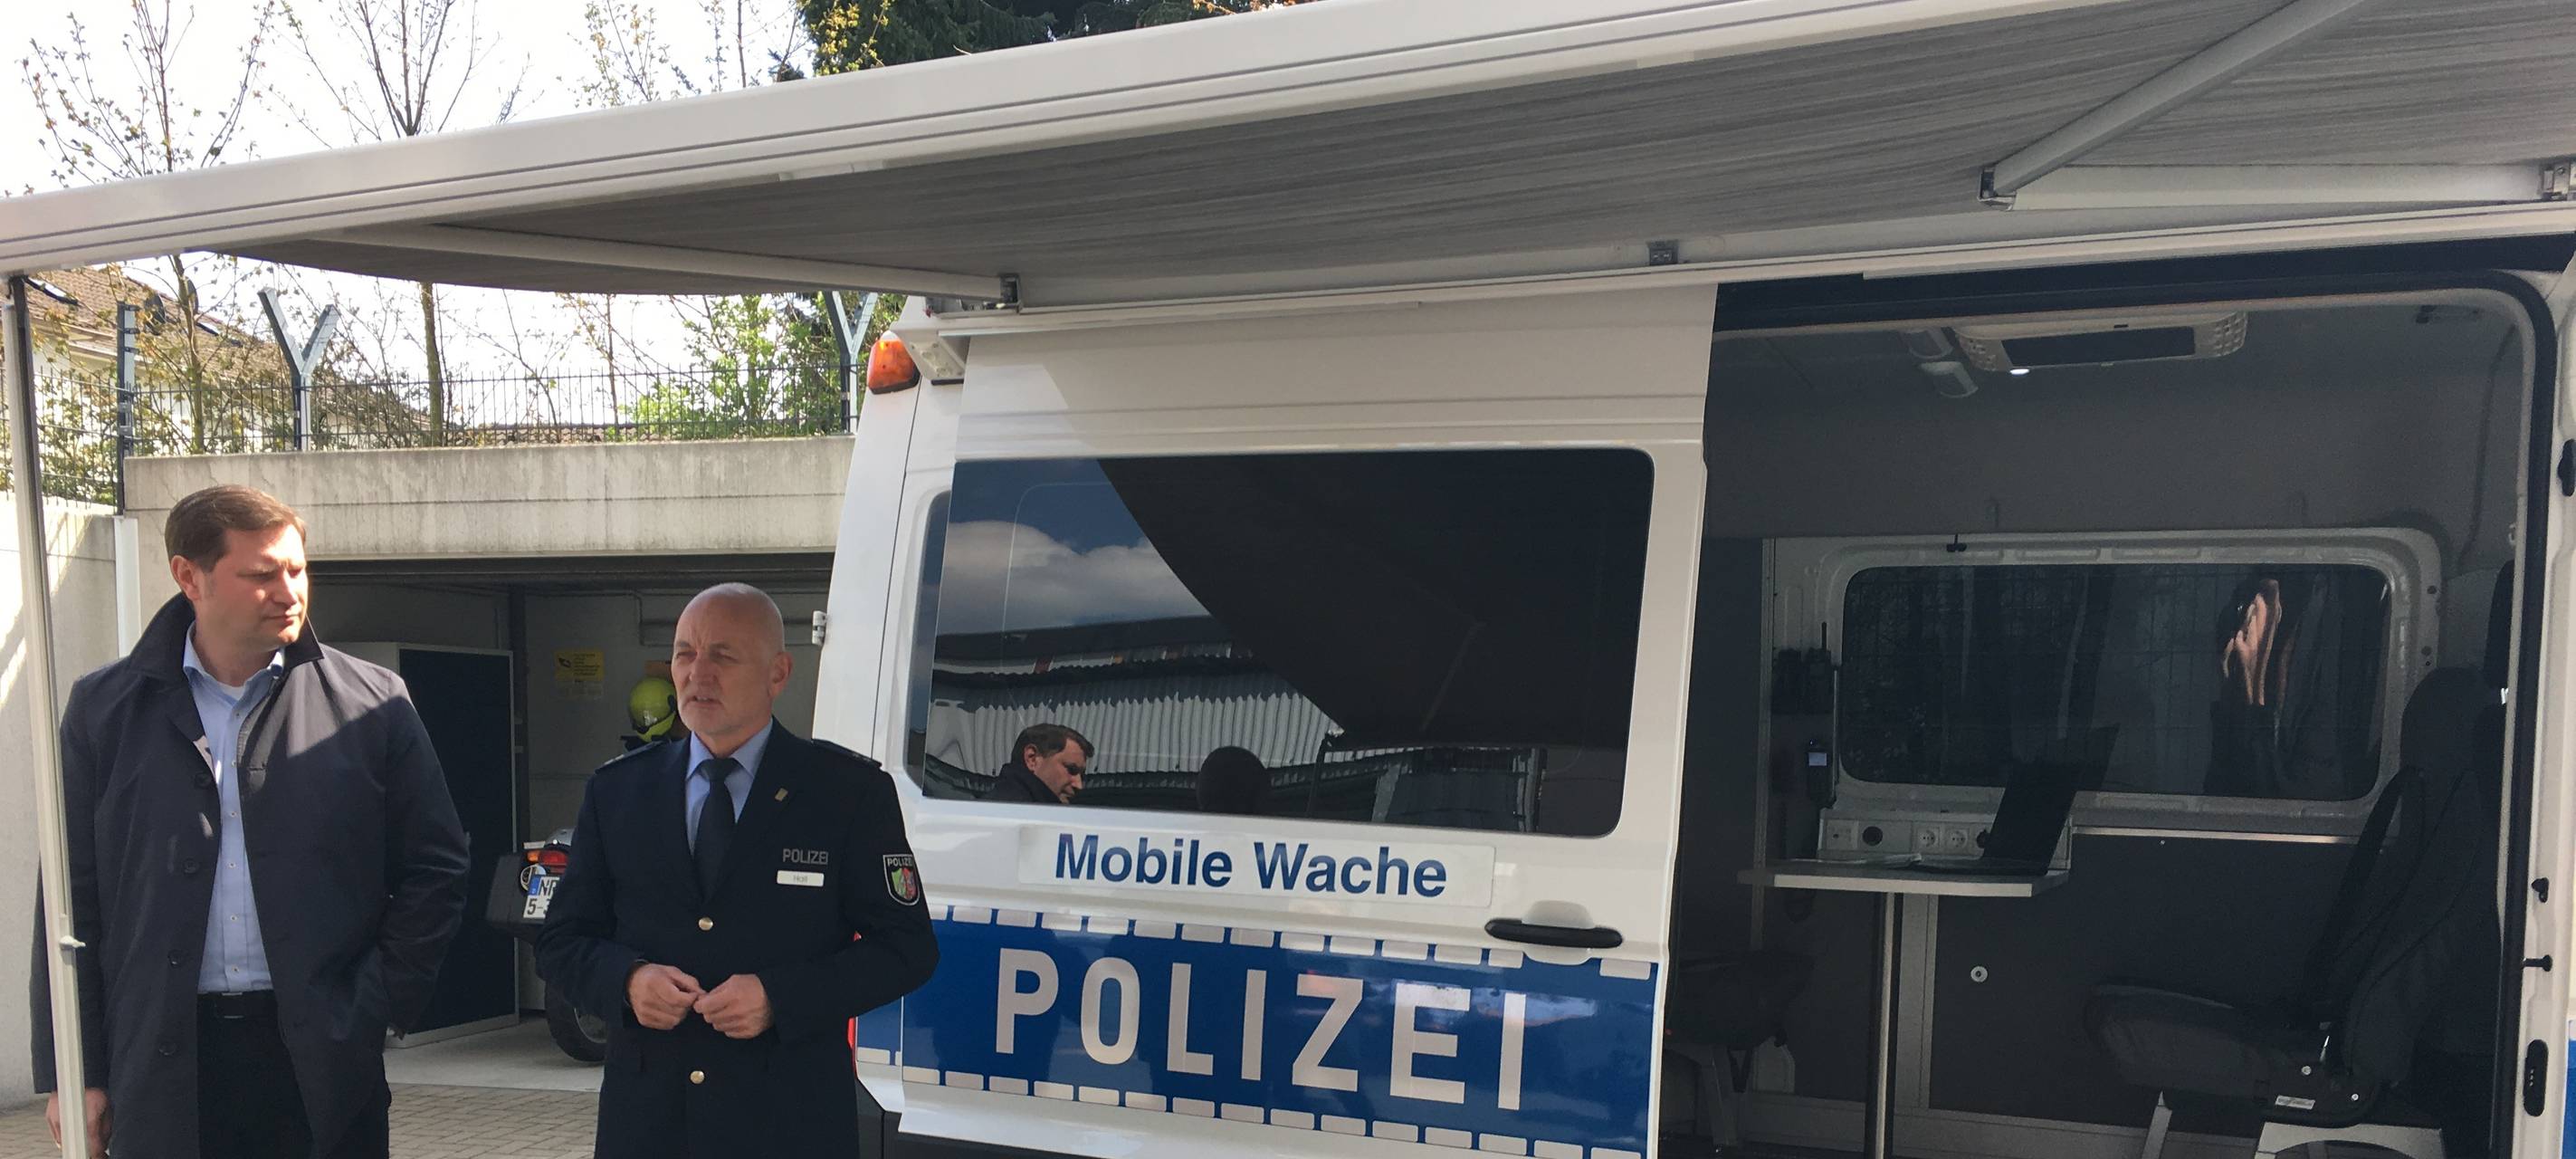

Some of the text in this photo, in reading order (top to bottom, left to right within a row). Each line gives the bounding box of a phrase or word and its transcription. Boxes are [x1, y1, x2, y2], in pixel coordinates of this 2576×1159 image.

[782, 848, 829, 866] POLIZEI
[886, 857, 913, 867] POLIZE
[1055, 833, 1447, 897] Mobile Wache
[996, 947, 1527, 1110] POLIZEI
